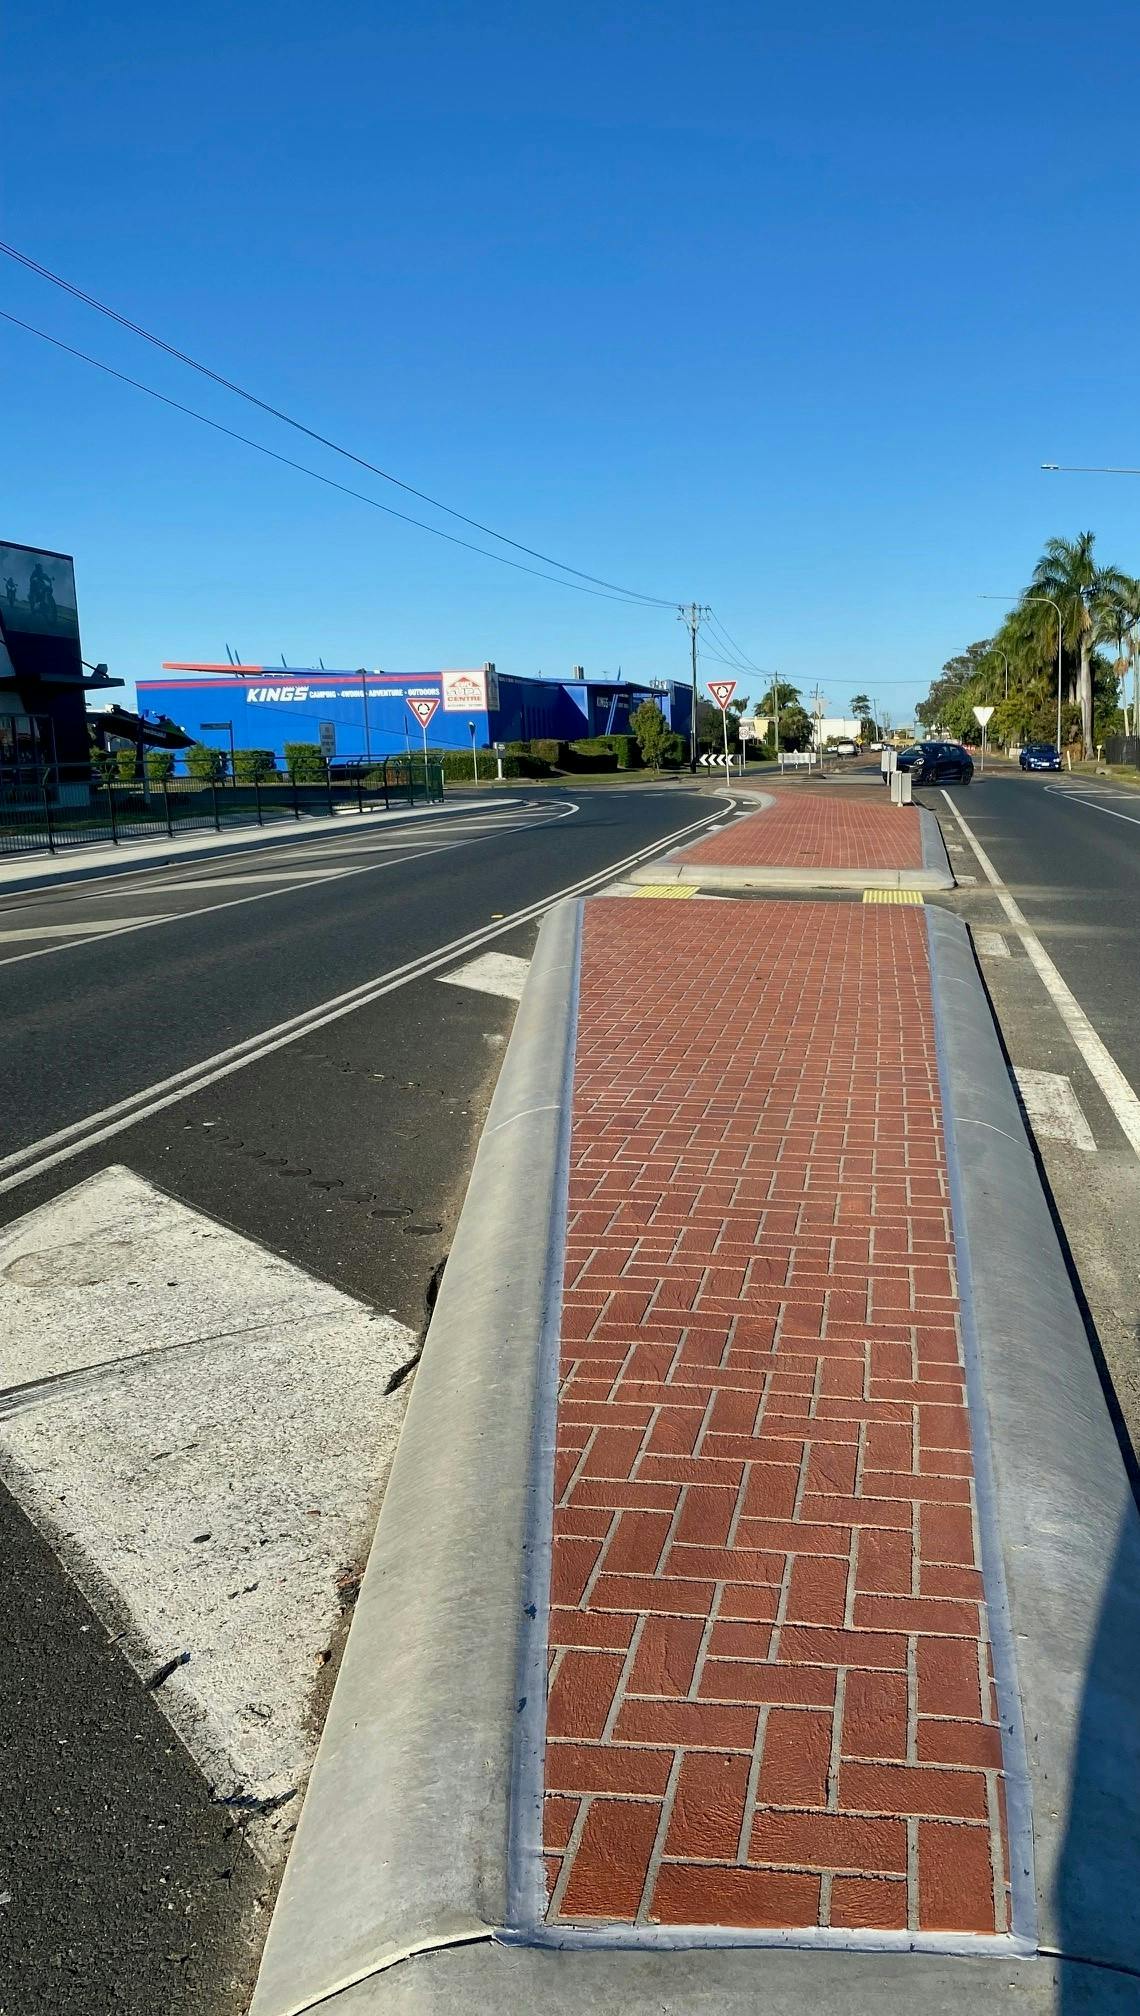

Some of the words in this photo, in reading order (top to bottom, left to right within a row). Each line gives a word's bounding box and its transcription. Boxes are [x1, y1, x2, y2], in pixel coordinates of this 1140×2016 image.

[246, 686, 310, 702] KINGS
[309, 690, 337, 699] CAMPING
[368, 688, 404, 698] ADVENTURE
[407, 687, 440, 697] OUTDOORS
